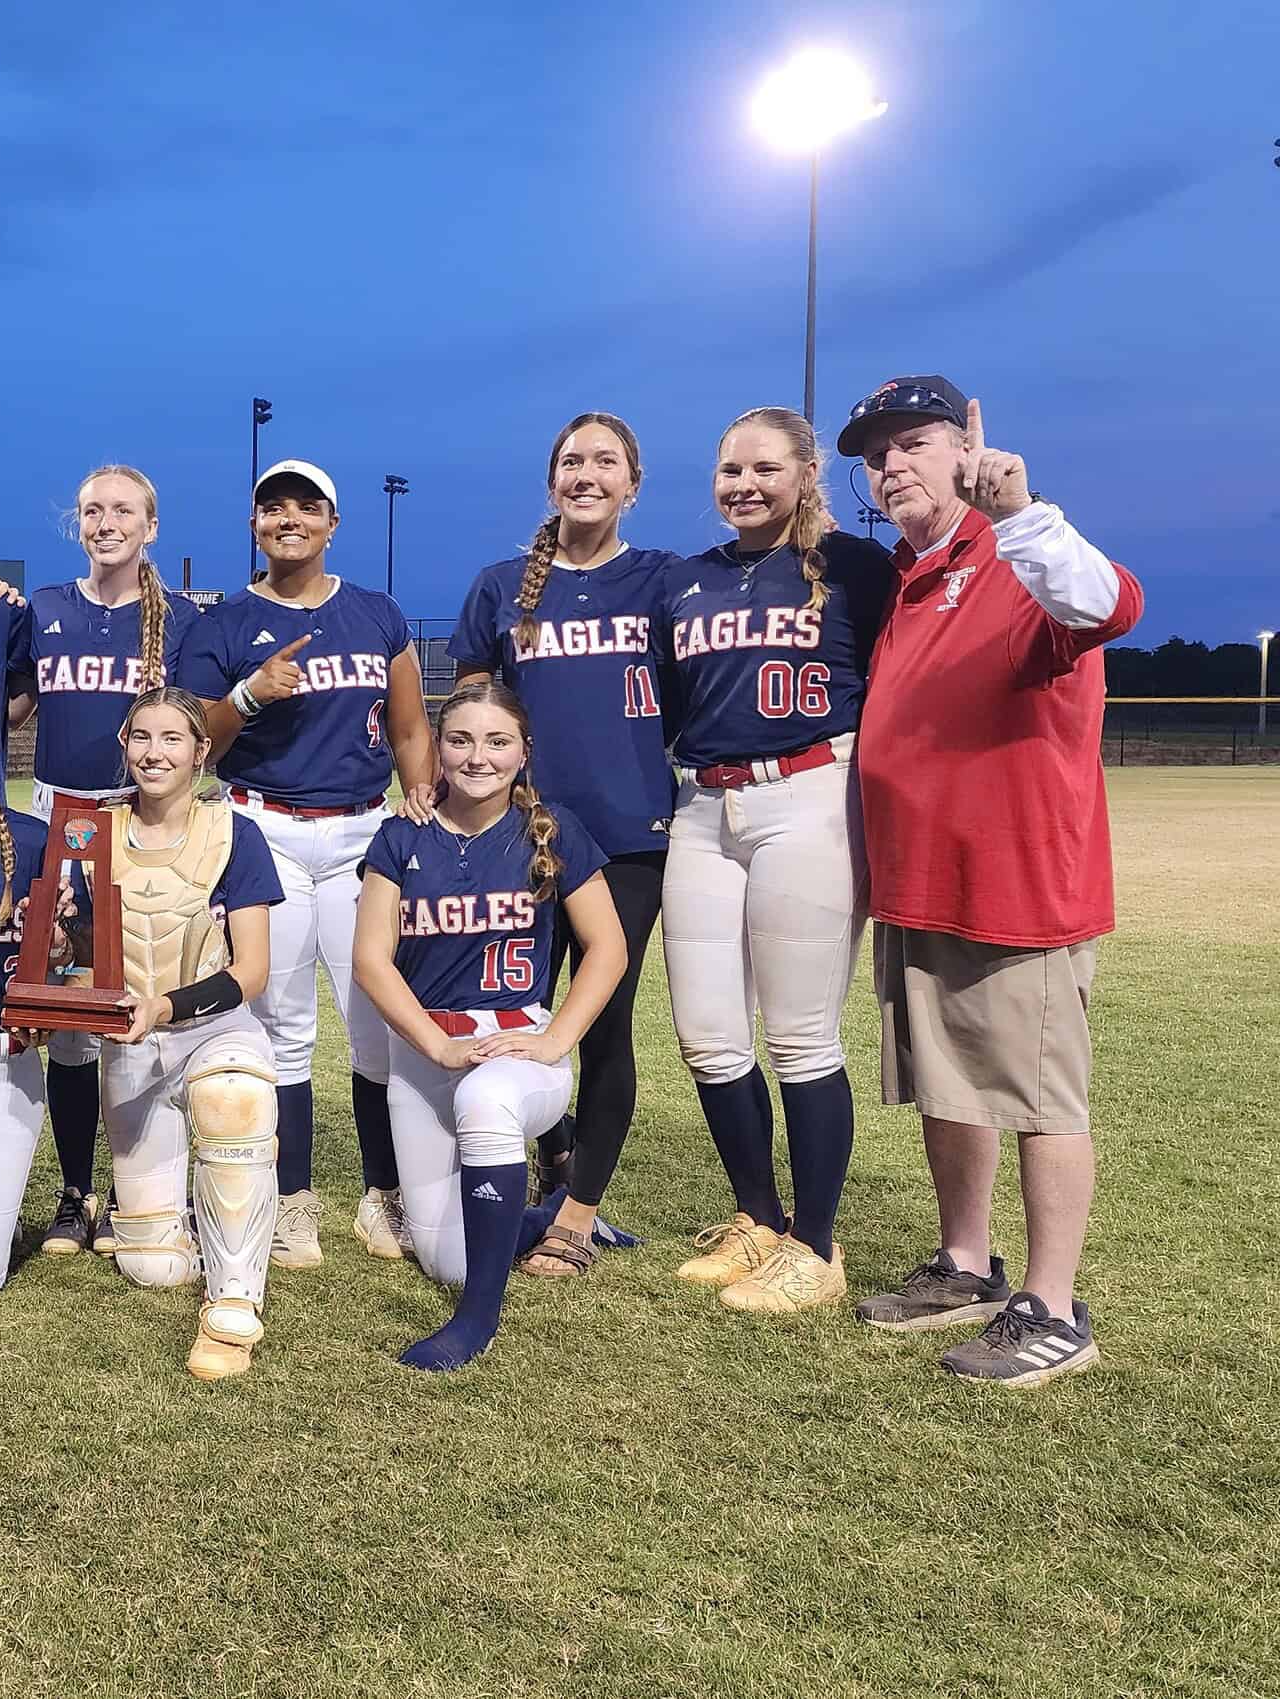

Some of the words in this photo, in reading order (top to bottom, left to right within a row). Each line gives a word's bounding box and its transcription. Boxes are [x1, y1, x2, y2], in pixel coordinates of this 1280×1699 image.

[673, 607, 822, 662] EAGLES
[287, 653, 388, 694] GLES
[624, 664, 661, 718] 11
[757, 660, 832, 718] 06
[366, 699, 385, 748] 4
[399, 890, 536, 937] EAGLES
[480, 938, 536, 991] 15
